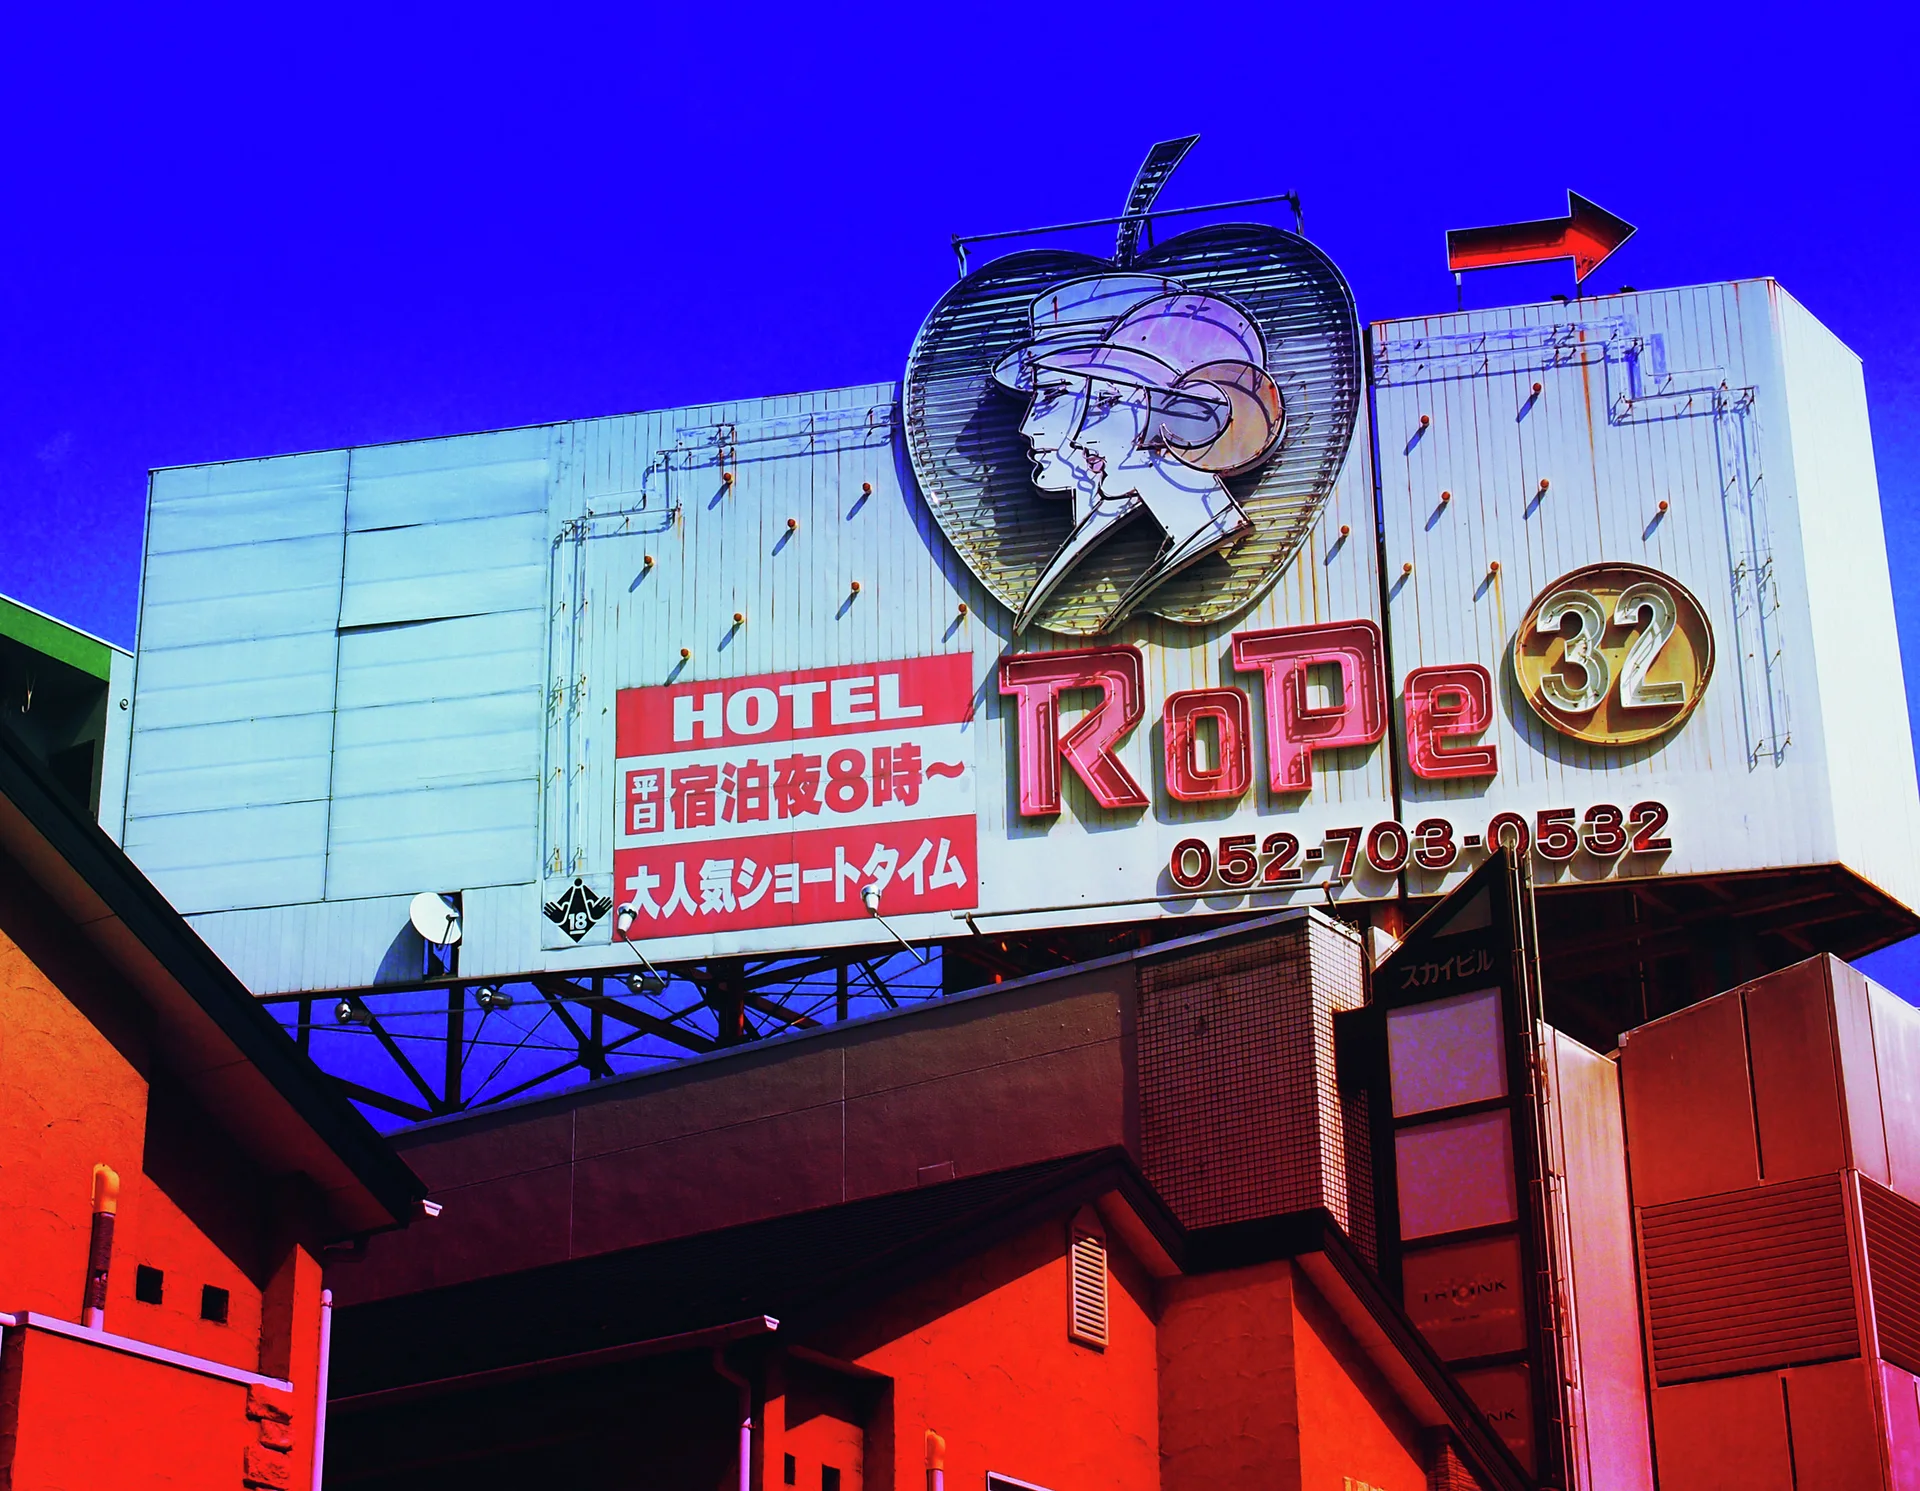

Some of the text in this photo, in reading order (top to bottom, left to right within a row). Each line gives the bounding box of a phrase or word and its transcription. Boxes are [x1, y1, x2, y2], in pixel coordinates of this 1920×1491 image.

[1535, 581, 1686, 714] 32
[673, 673, 923, 742] HOTEL
[625, 836, 968, 921] 大人気ショートタイム
[1169, 800, 1673, 889] 052-703-0532
[568, 911, 588, 931] 18
[1400, 948, 1495, 990] スカイビル
